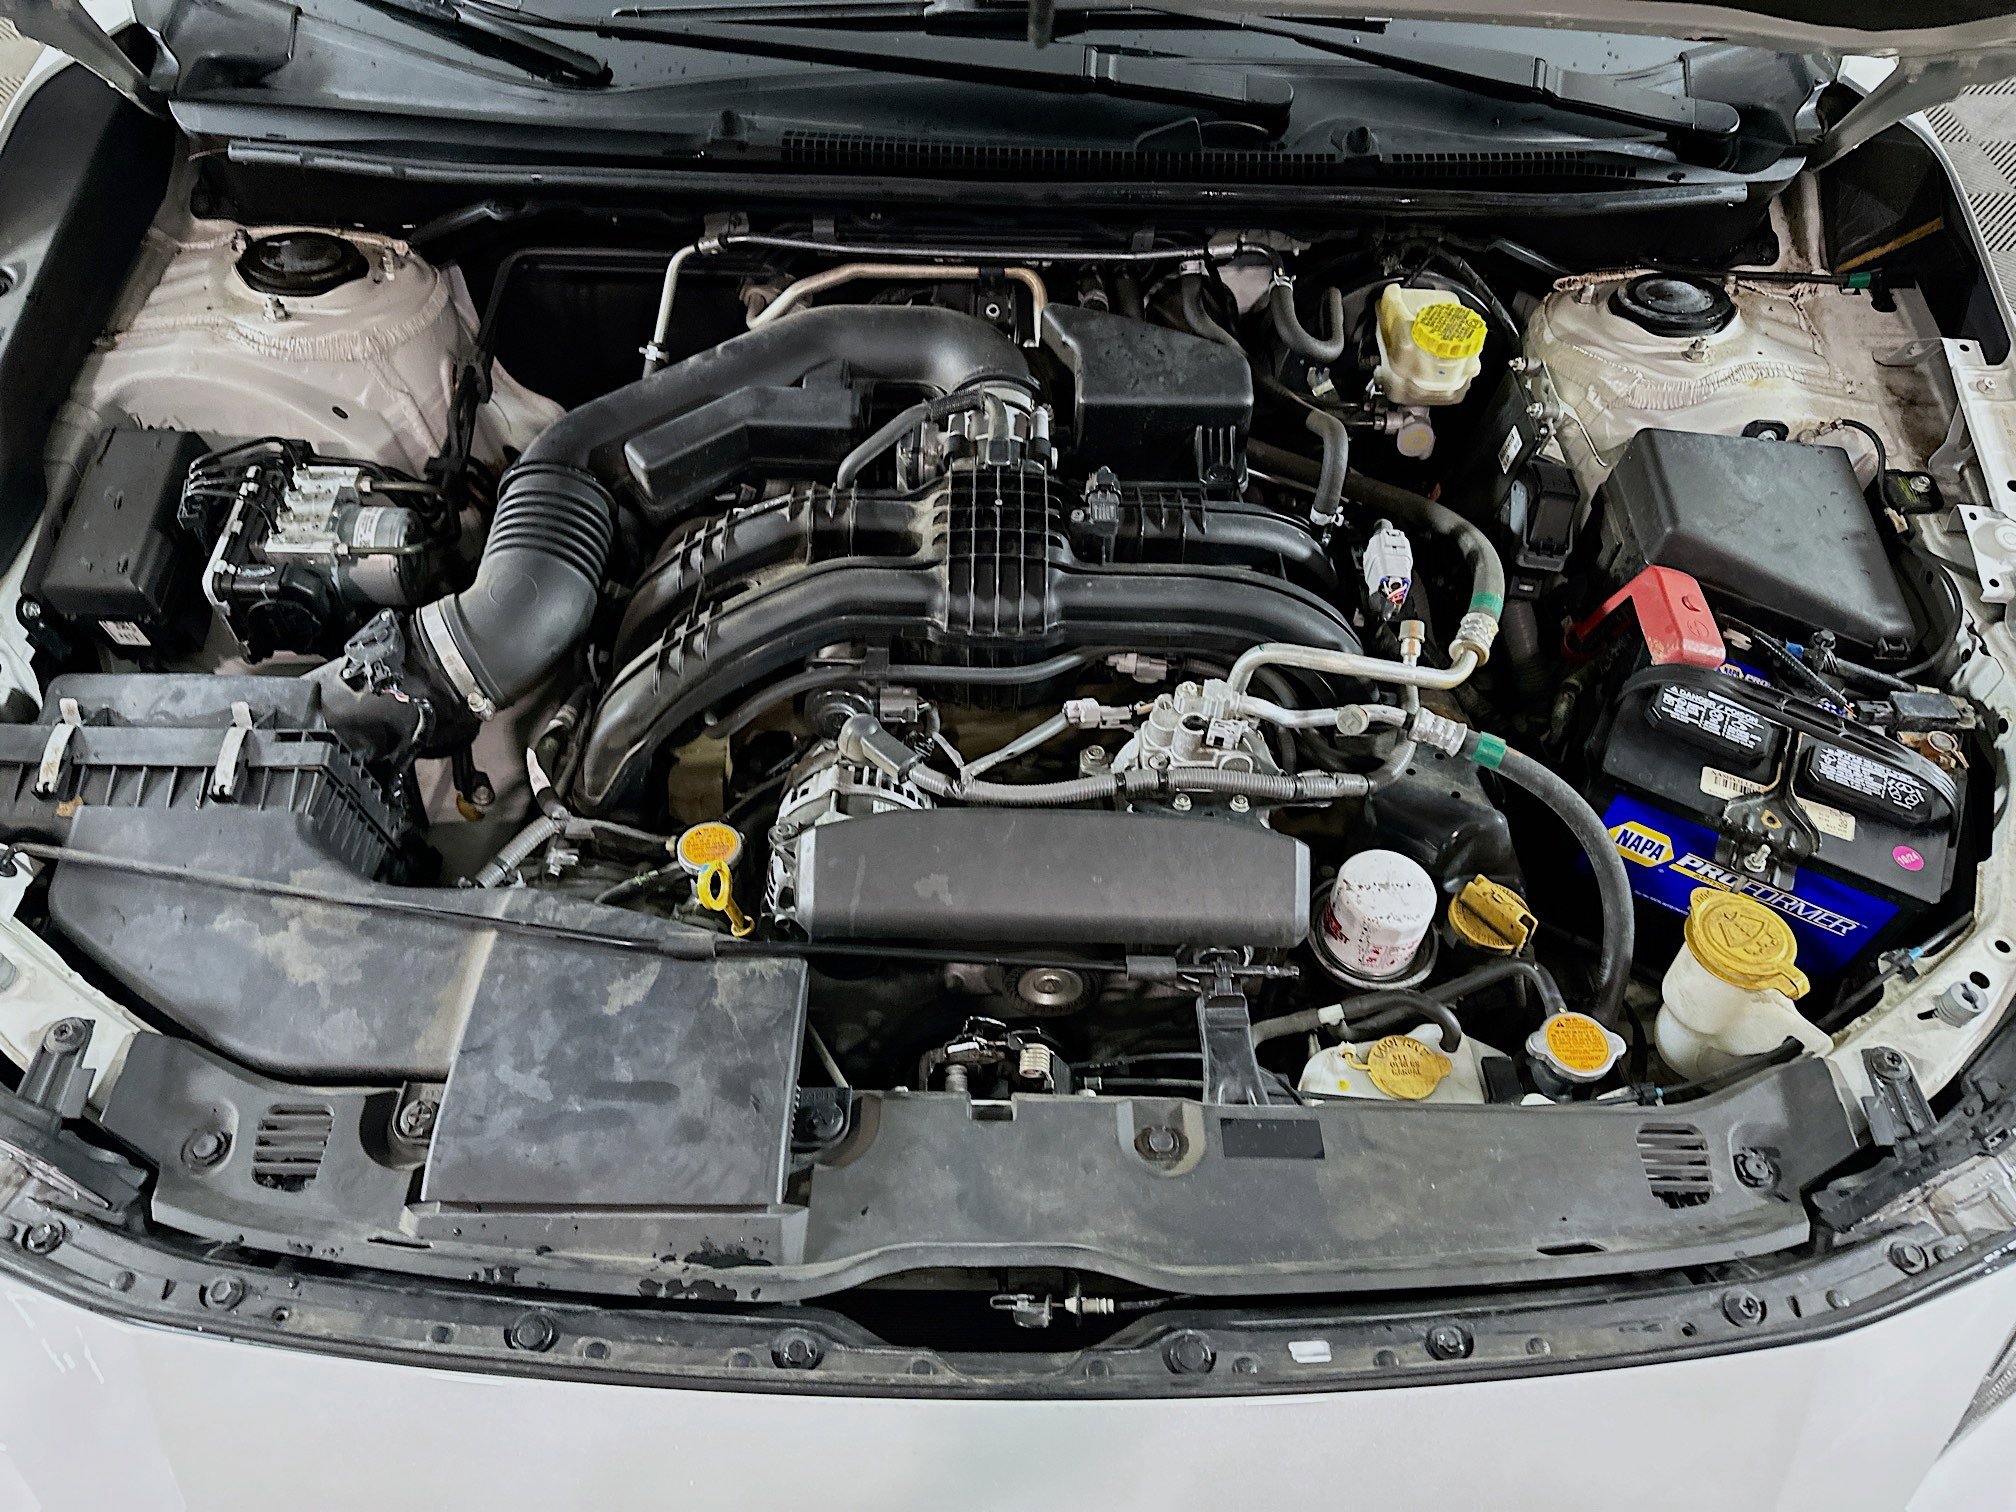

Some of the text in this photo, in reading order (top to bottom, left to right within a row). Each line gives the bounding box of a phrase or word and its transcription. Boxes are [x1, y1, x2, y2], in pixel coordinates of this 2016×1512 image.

[1679, 688, 1717, 708] DANGER
[1724, 706, 1760, 725] POISON
[1615, 828, 1665, 861] NAPA
[1675, 854, 1858, 935] PROFORMER
